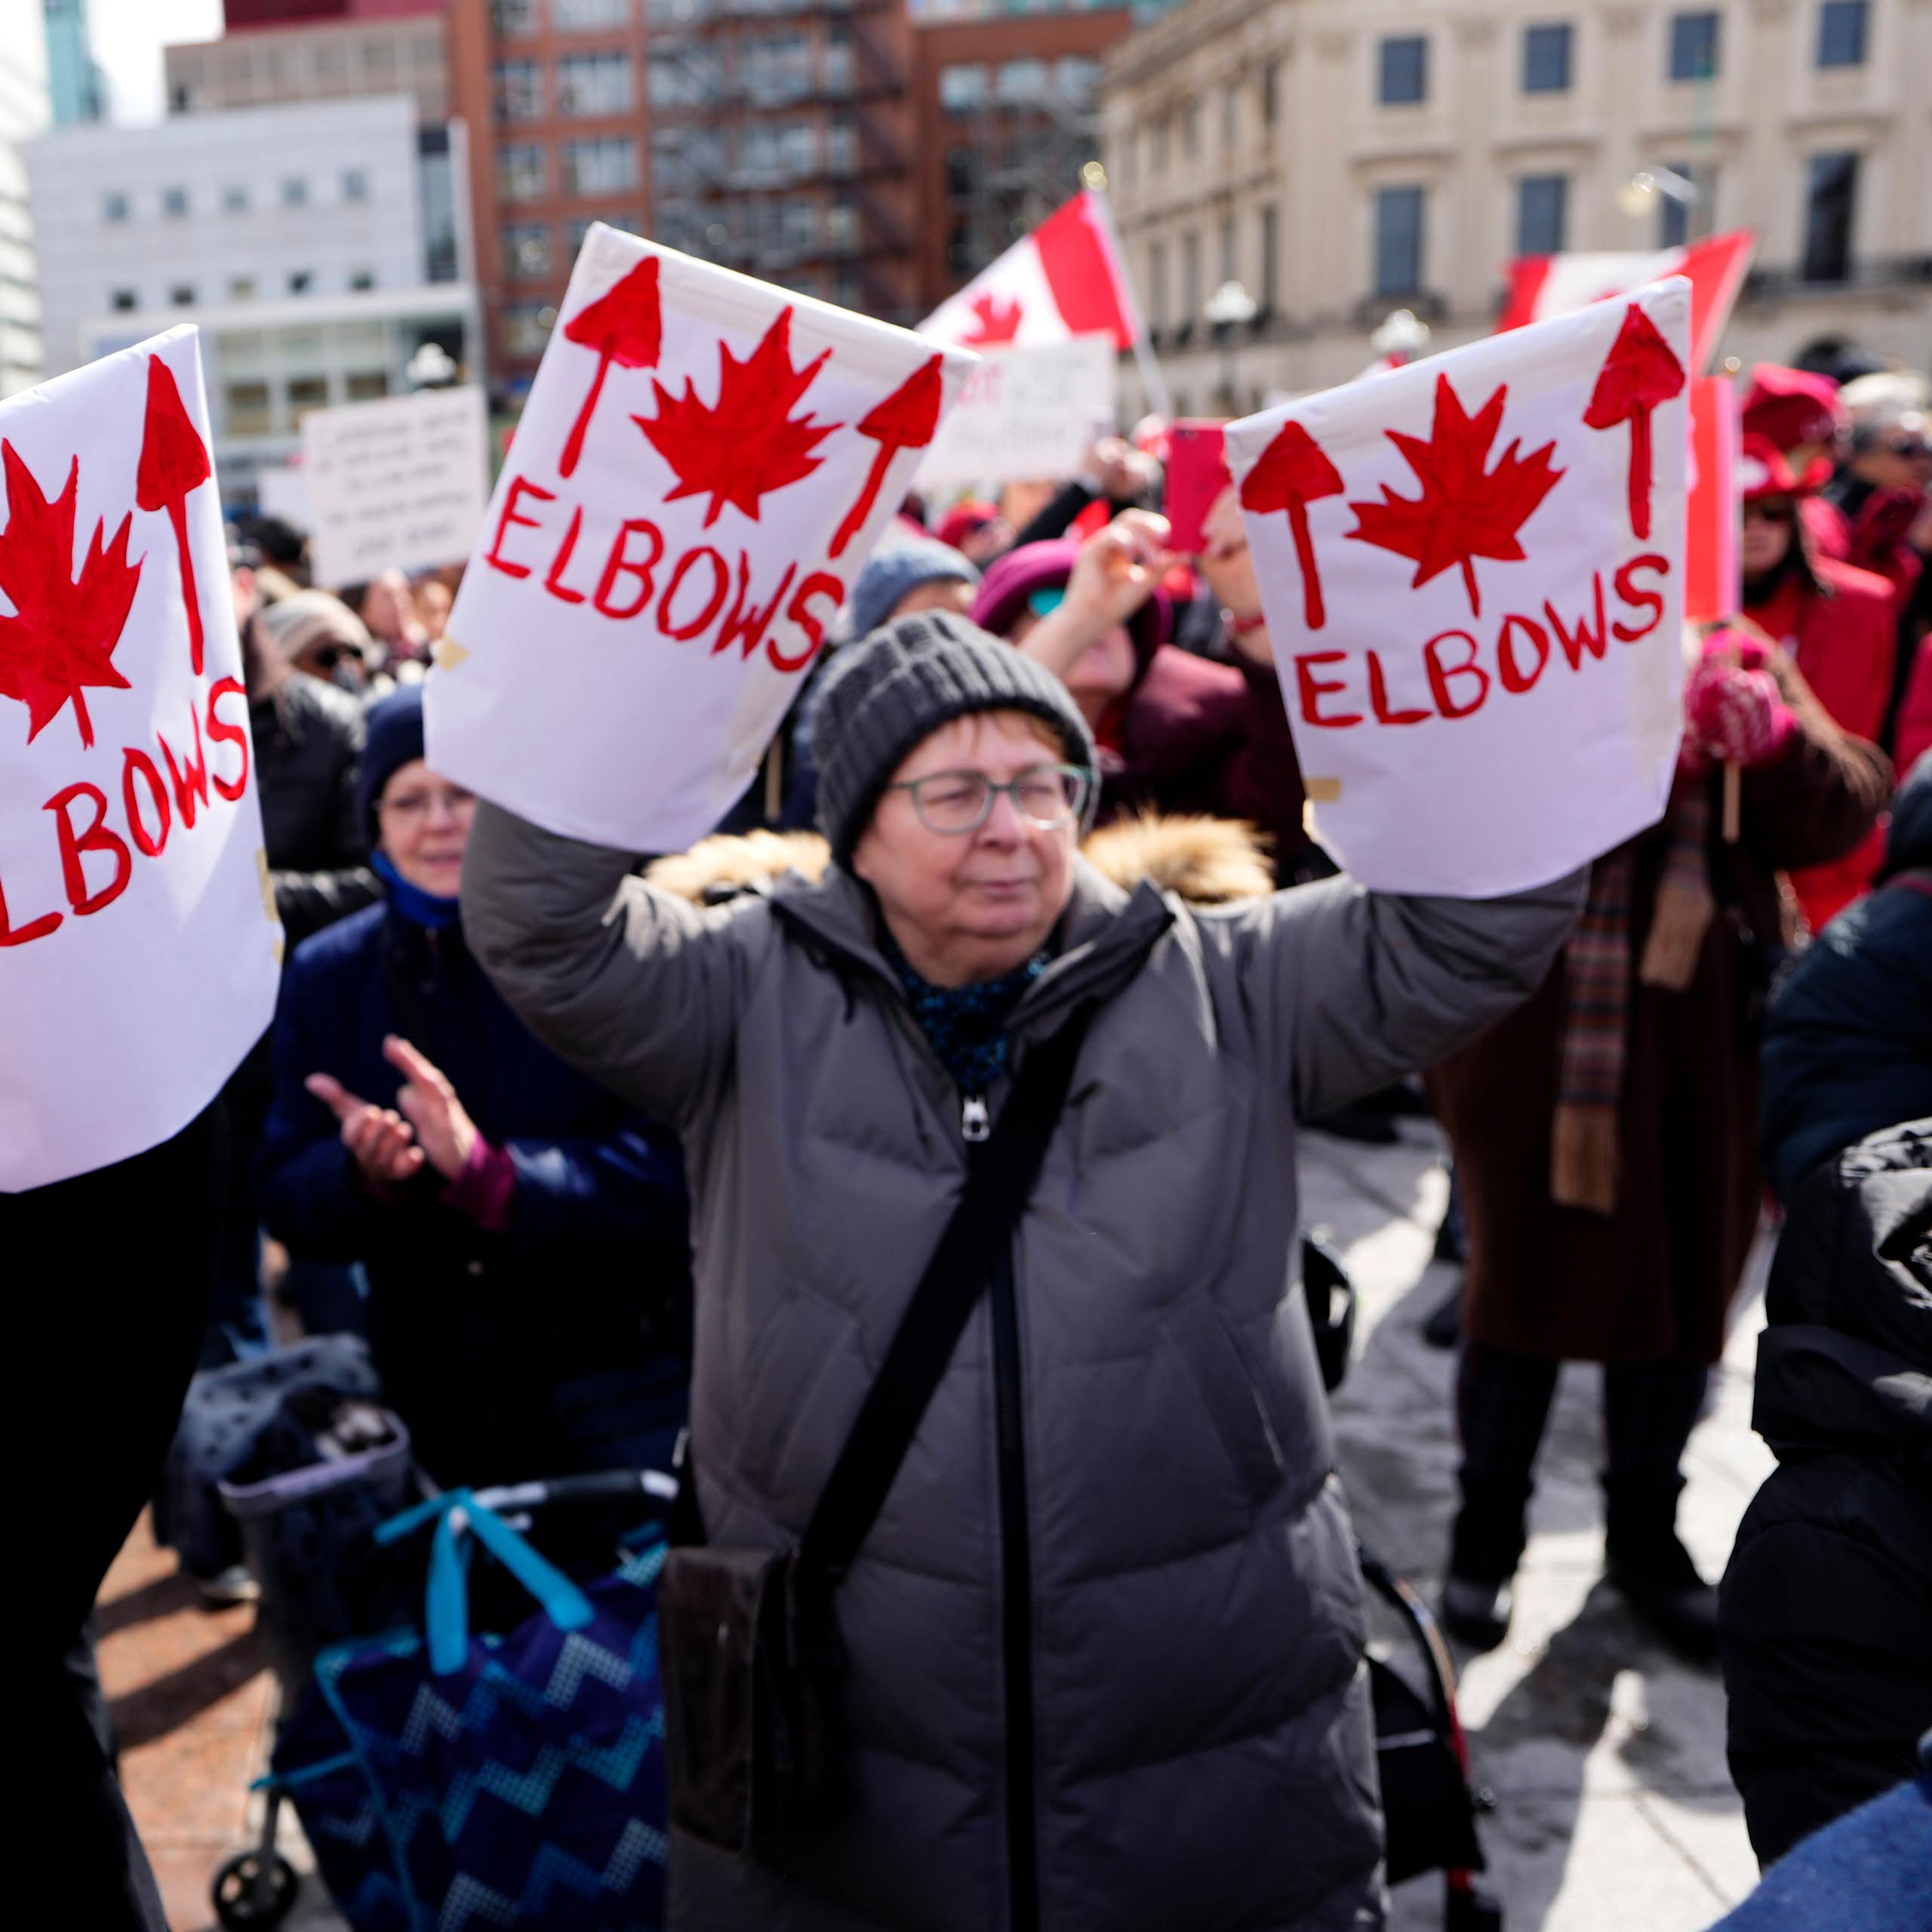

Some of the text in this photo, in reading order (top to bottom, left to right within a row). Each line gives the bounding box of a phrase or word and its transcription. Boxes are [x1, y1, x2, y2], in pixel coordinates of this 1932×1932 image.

[484, 475, 846, 674] ELBOWS
[1294, 553, 1671, 729] ELBOWS
[0, 675, 249, 948] LBOWS
